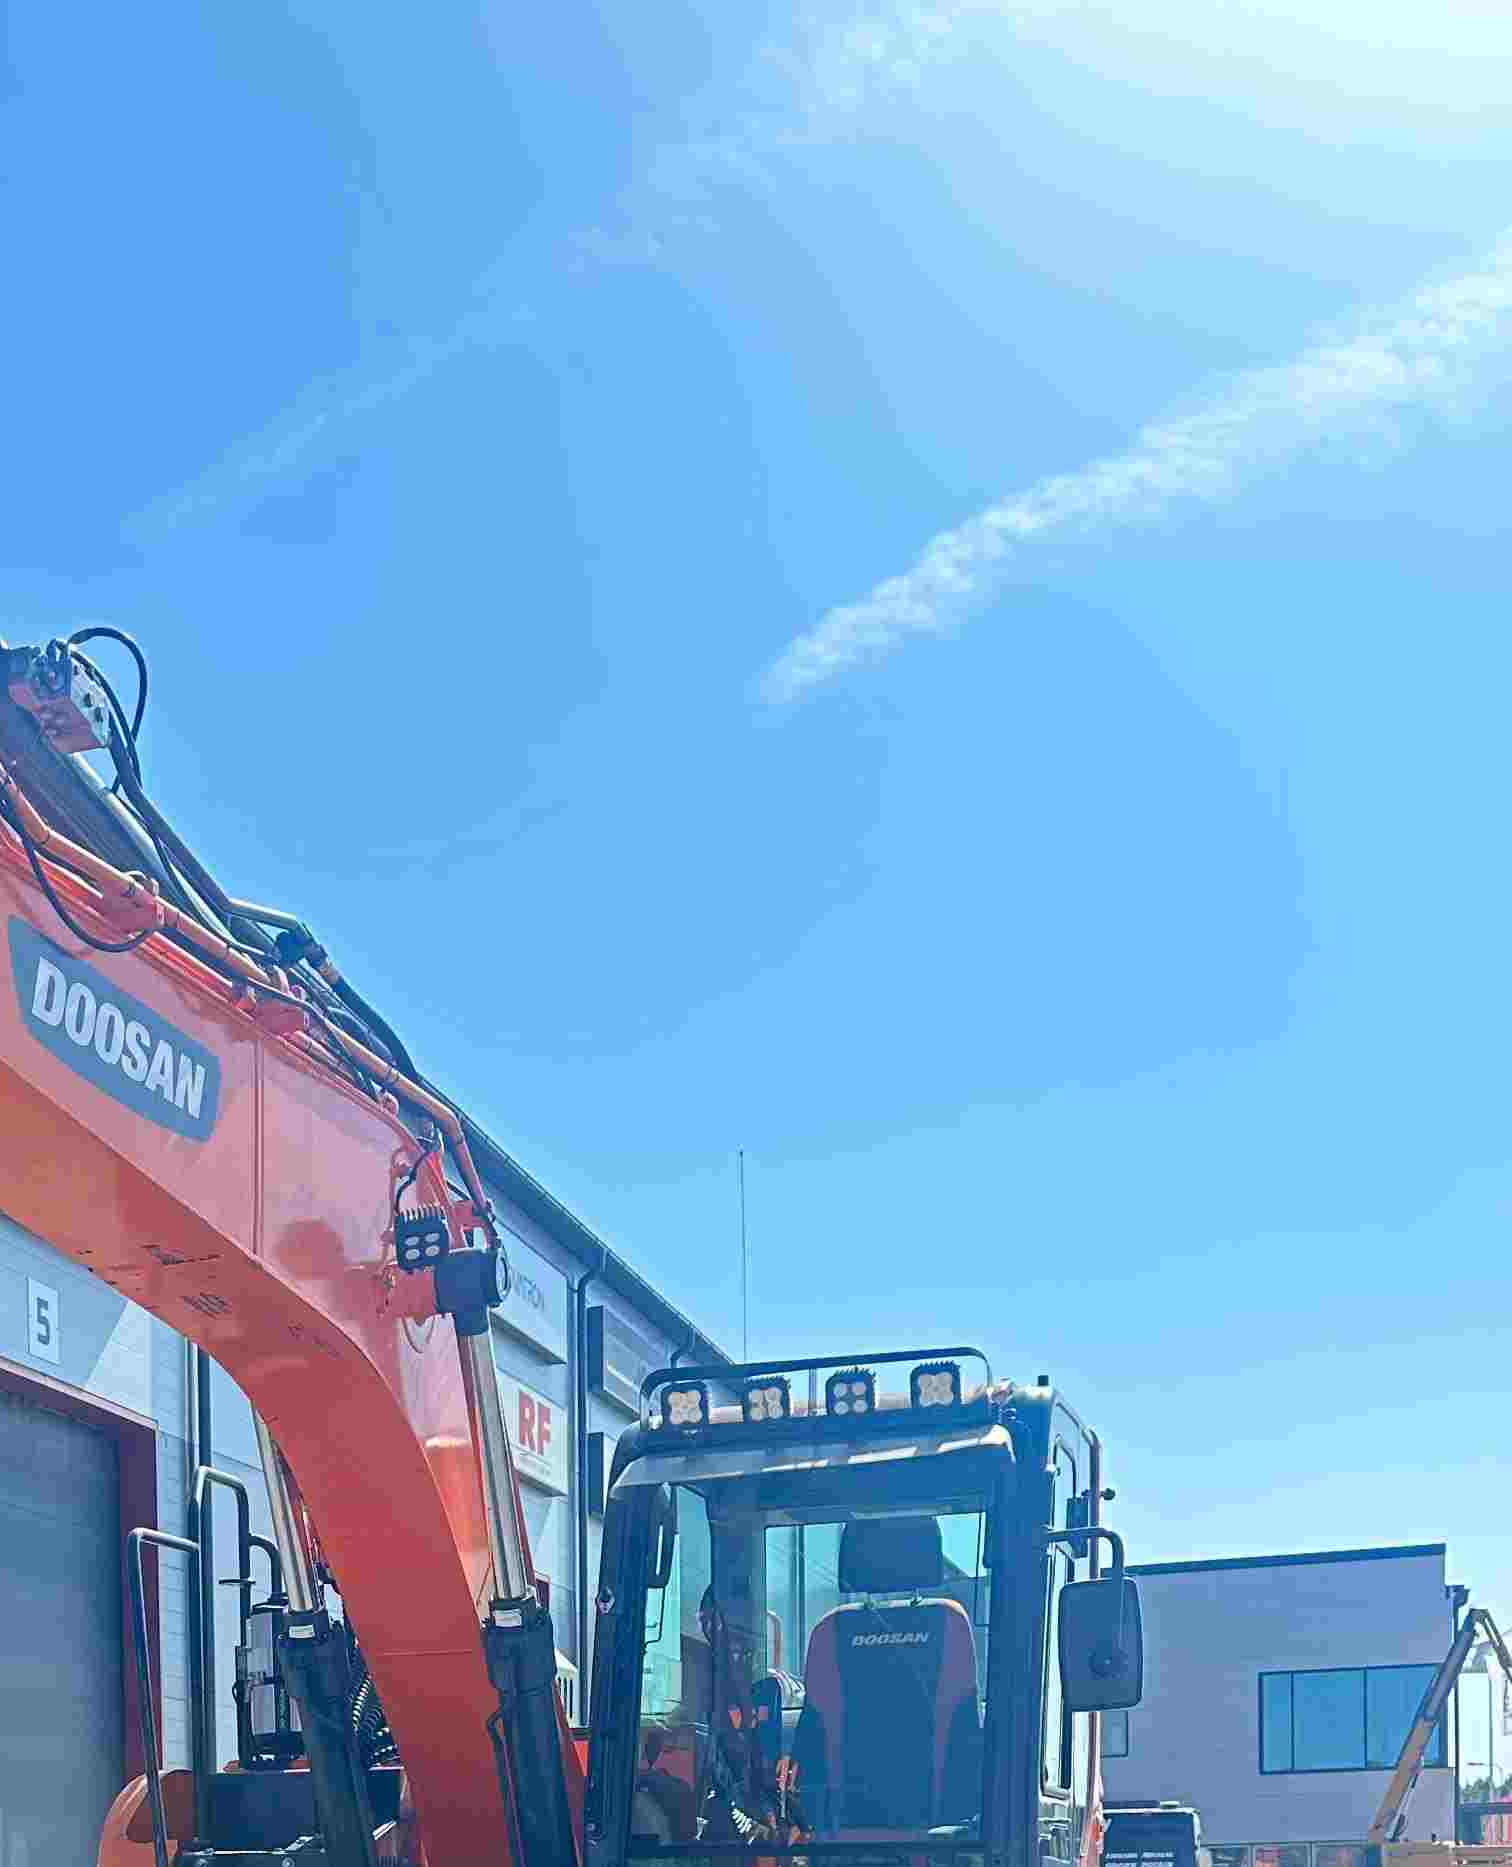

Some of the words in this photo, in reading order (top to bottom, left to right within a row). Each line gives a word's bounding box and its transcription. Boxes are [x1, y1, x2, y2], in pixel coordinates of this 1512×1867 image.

[31, 956, 206, 1120] DOOSAN
[36, 1297, 50, 1345] 5
[519, 1391, 551, 1456] RF
[851, 1632, 929, 1649] DOOSAN
